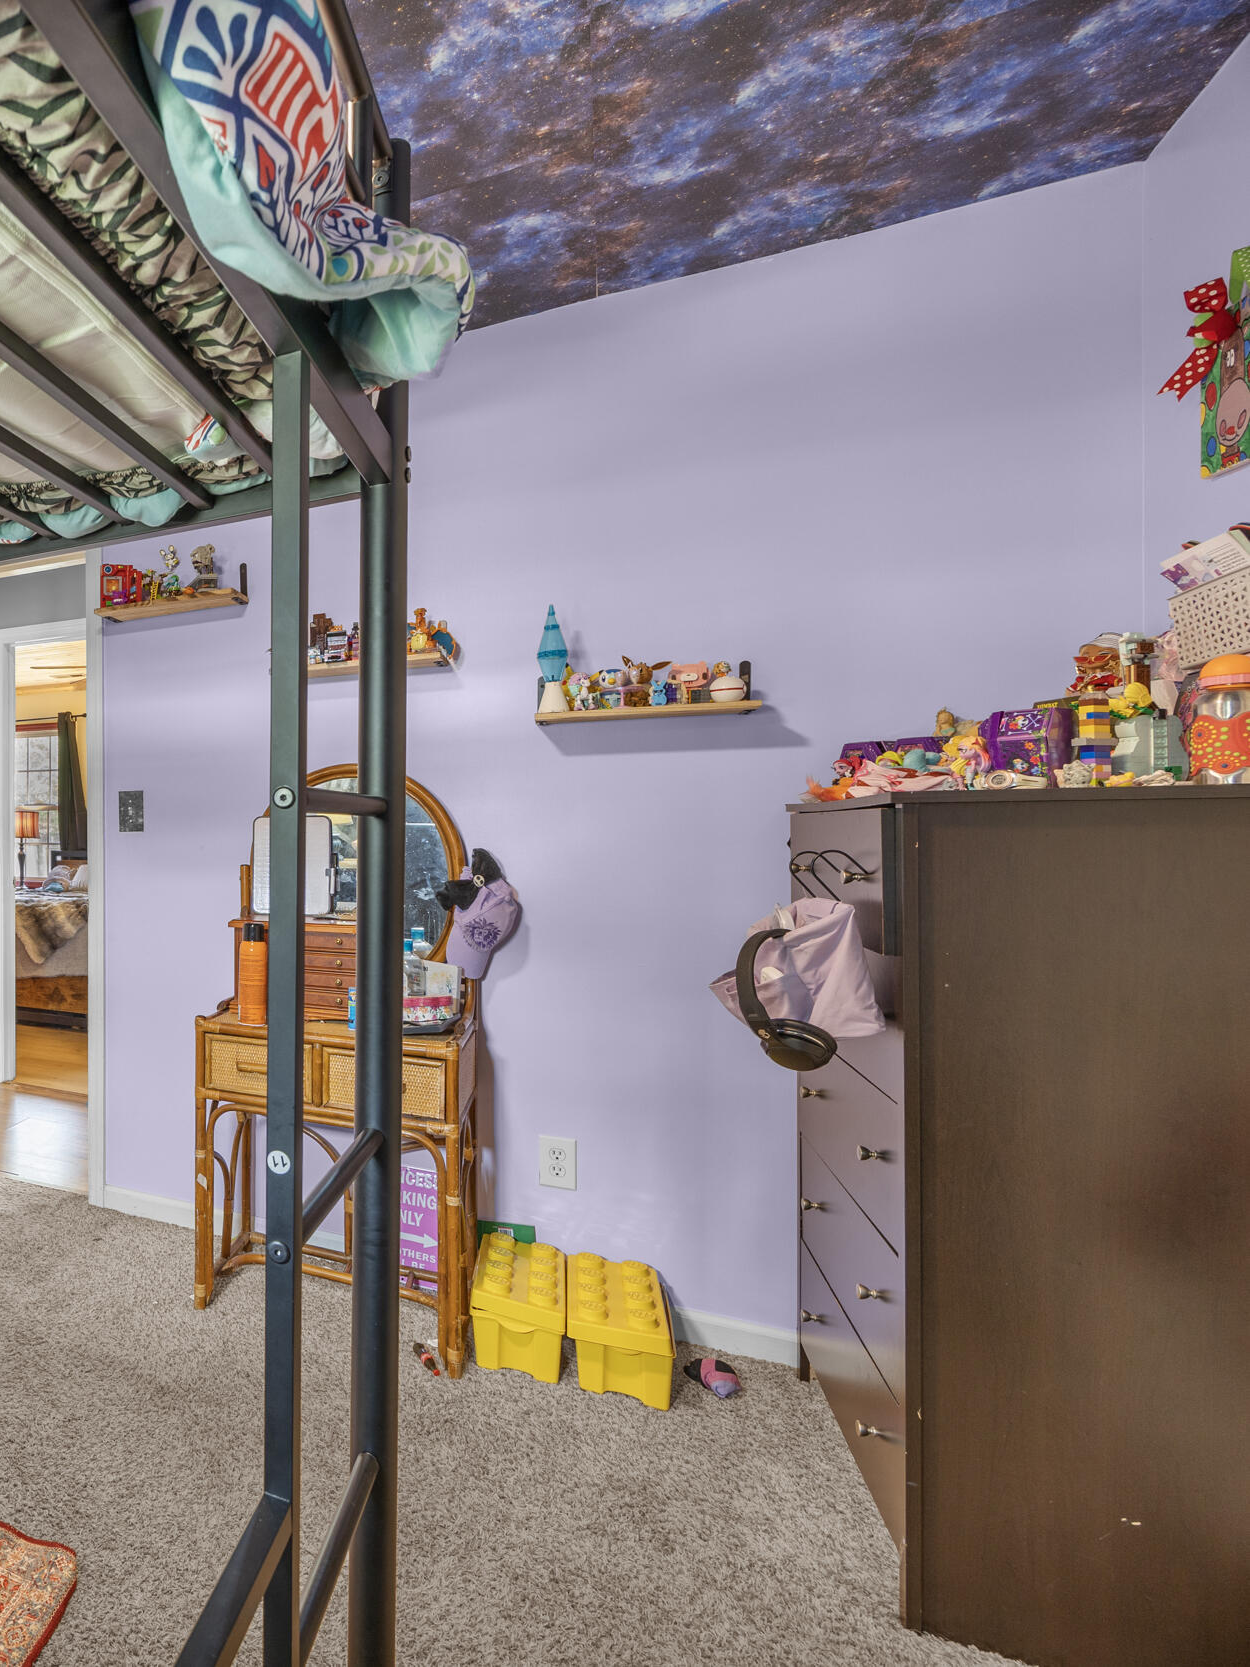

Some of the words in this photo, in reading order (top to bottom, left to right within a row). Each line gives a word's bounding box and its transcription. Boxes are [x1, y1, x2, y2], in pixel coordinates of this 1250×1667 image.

[401, 1190, 437, 1210] KING
[400, 1209, 424, 1227] NLY
[400, 1247, 437, 1264] THERS
